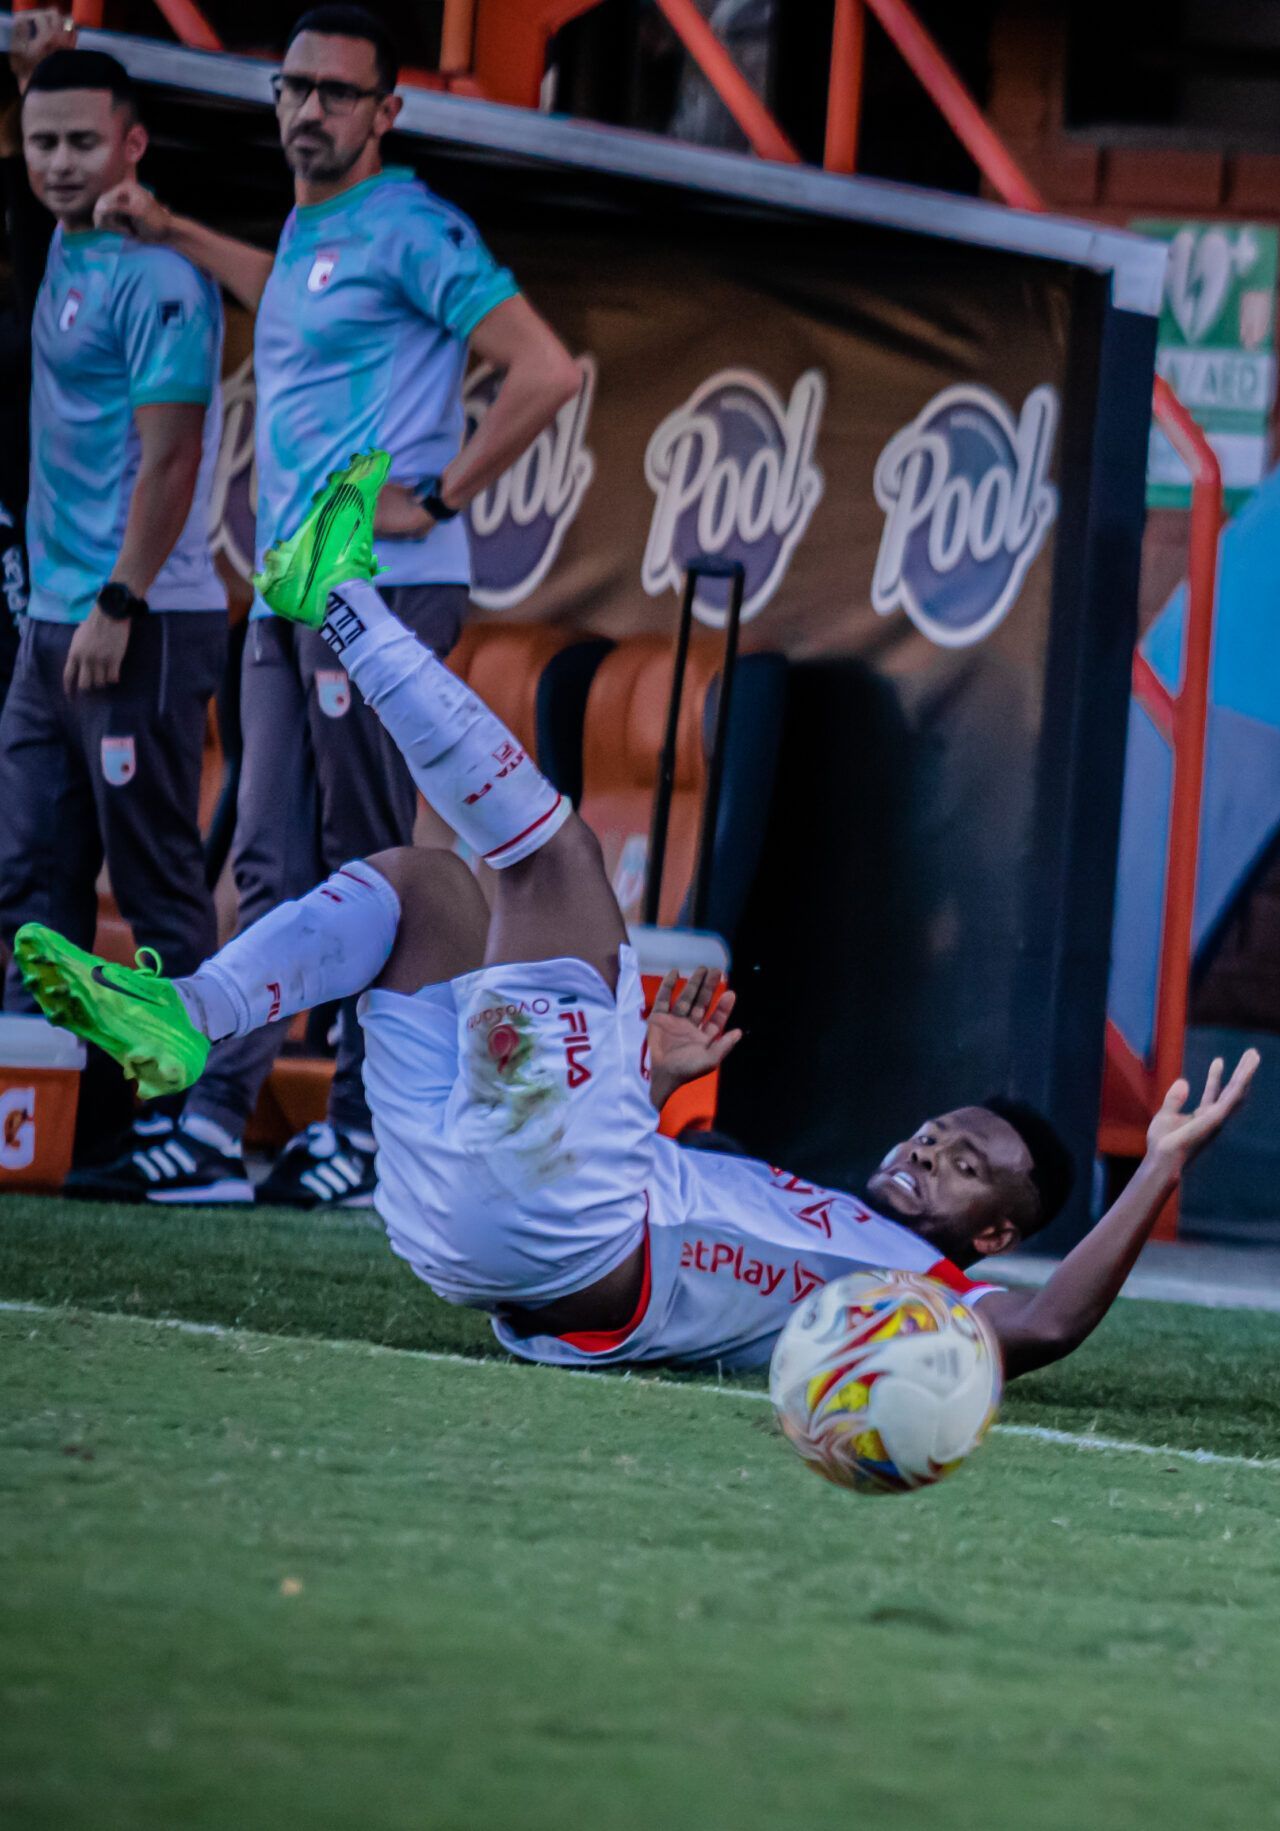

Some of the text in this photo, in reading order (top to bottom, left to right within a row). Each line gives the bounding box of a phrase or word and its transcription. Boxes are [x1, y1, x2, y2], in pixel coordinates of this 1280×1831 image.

[468, 355, 595, 537] ool
[645, 371, 824, 593] Pool
[873, 385, 1060, 614] Pool
[559, 1011, 592, 1089] FILA
[680, 1240, 786, 1296] etPlay
